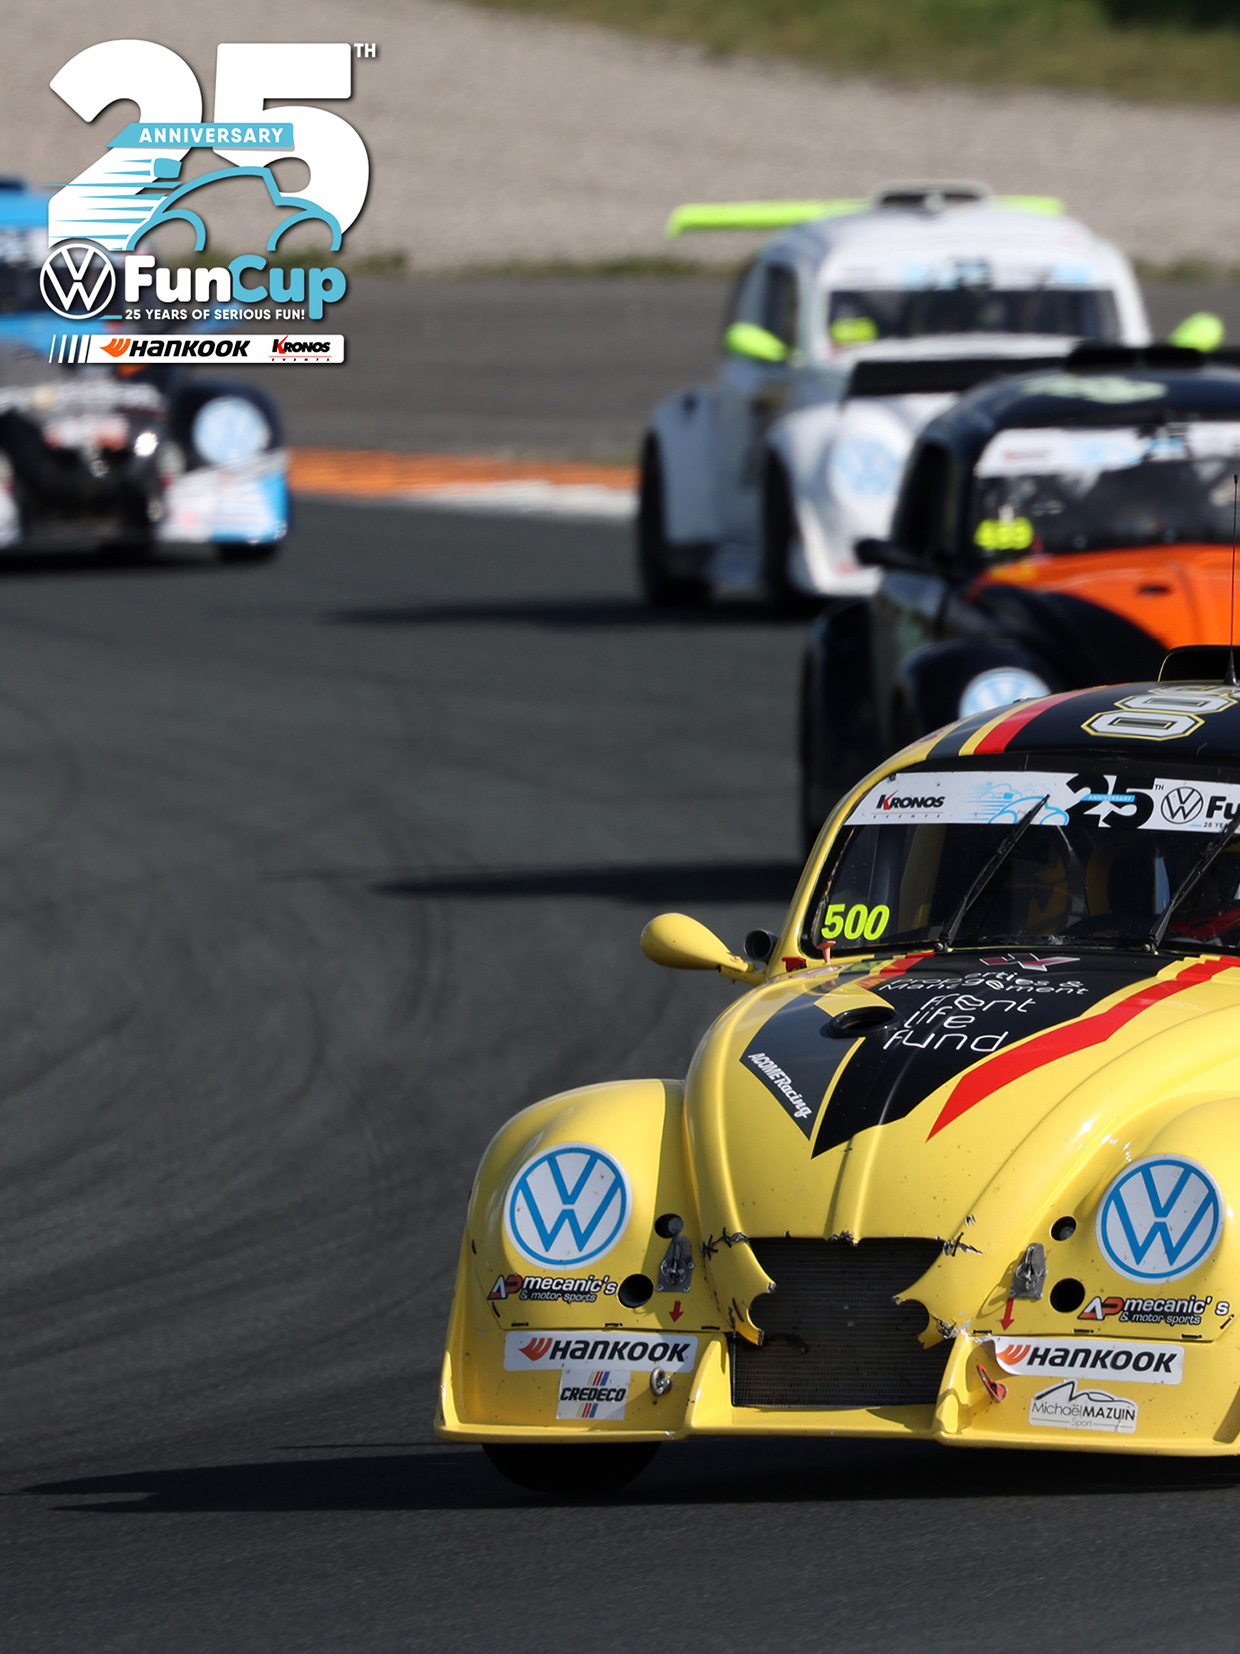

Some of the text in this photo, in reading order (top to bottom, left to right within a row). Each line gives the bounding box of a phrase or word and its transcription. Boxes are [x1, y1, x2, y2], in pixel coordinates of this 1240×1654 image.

[875, 789, 946, 811] KRONOS
[821, 903, 890, 940] 500
[903, 1006, 976, 1029] life
[882, 1029, 1009, 1052] fund
[521, 1274, 618, 1296] mecanic's
[519, 1290, 597, 1304] & motor sports
[1119, 1313, 1202, 1325] & motor sports
[549, 1338, 692, 1363] HANKOOK
[1026, 1347, 1178, 1374] HANKOOK
[560, 1386, 628, 1402] CREDECO
[1070, 1417, 1094, 1429] Sport
[1083, 1405, 1136, 1422] MAZUIN
